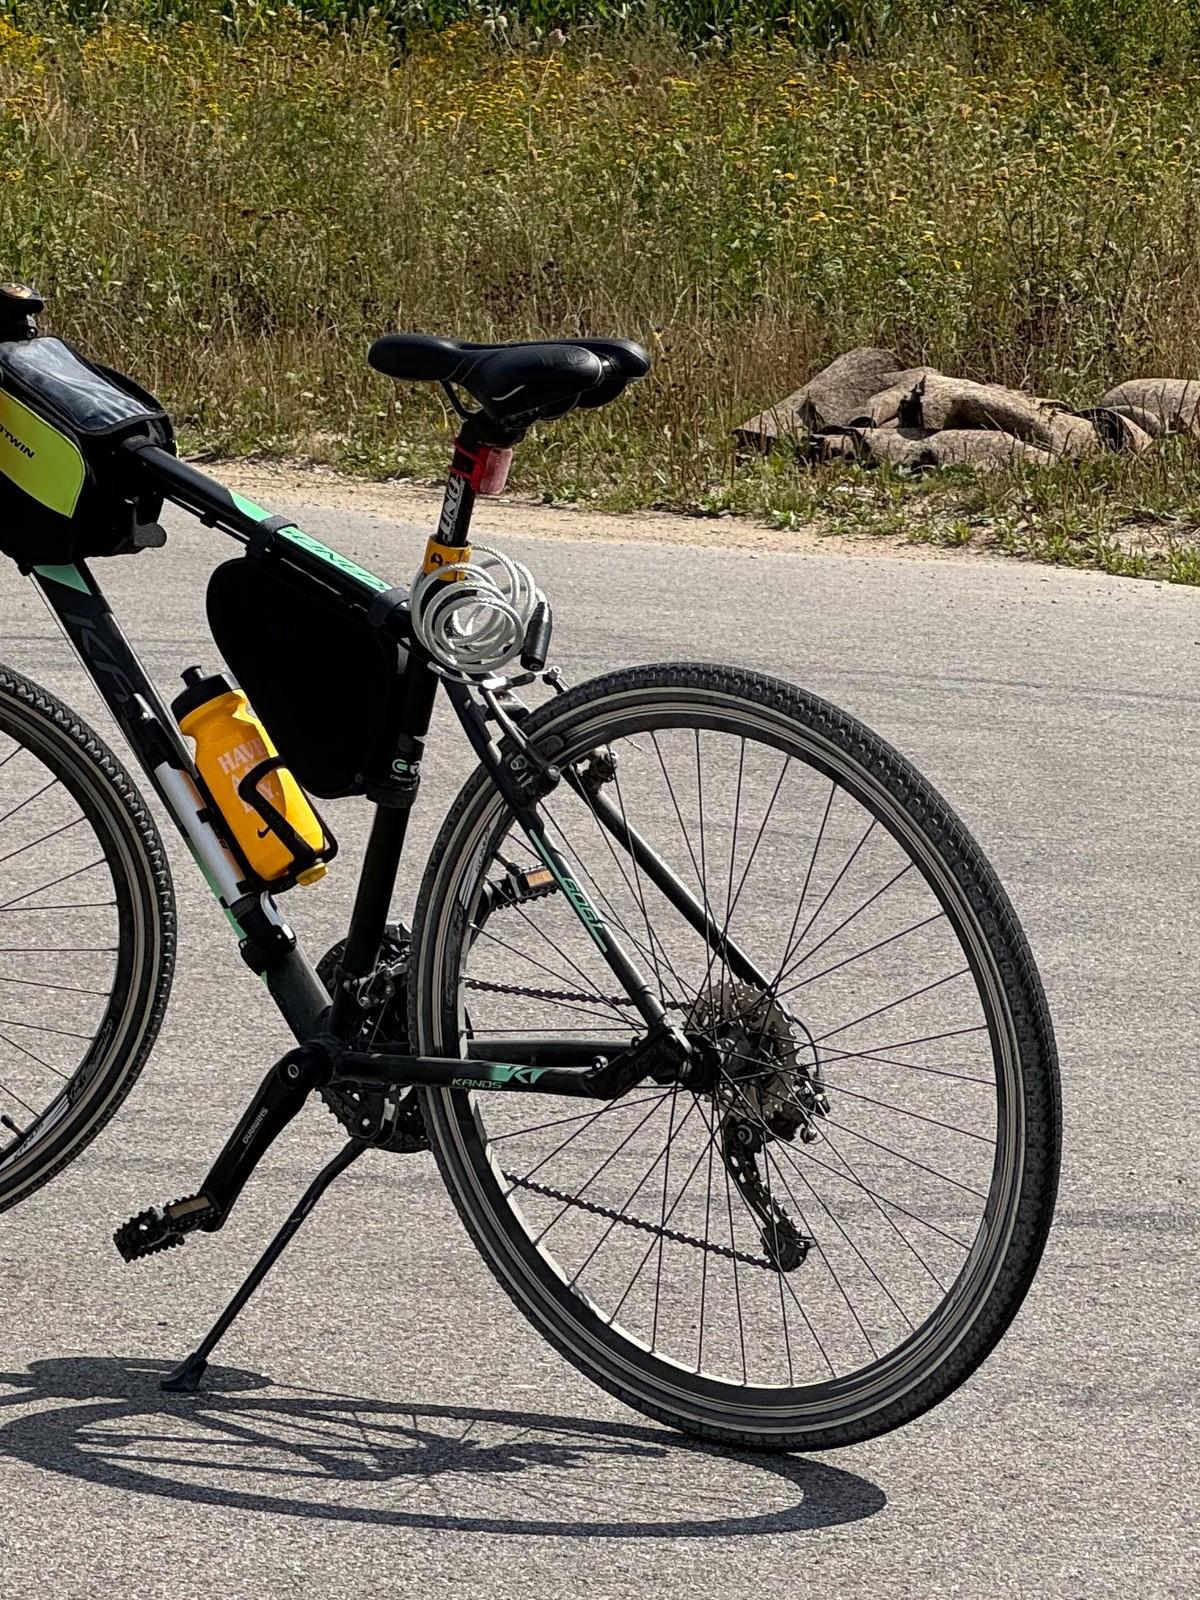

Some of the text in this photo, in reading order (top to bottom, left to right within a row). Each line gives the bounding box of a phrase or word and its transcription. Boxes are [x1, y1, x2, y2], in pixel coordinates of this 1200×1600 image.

[439, 475, 461, 535] UNO
[217, 738, 267, 775] HAVE
[242, 1106, 269, 1145] SHIMANO
